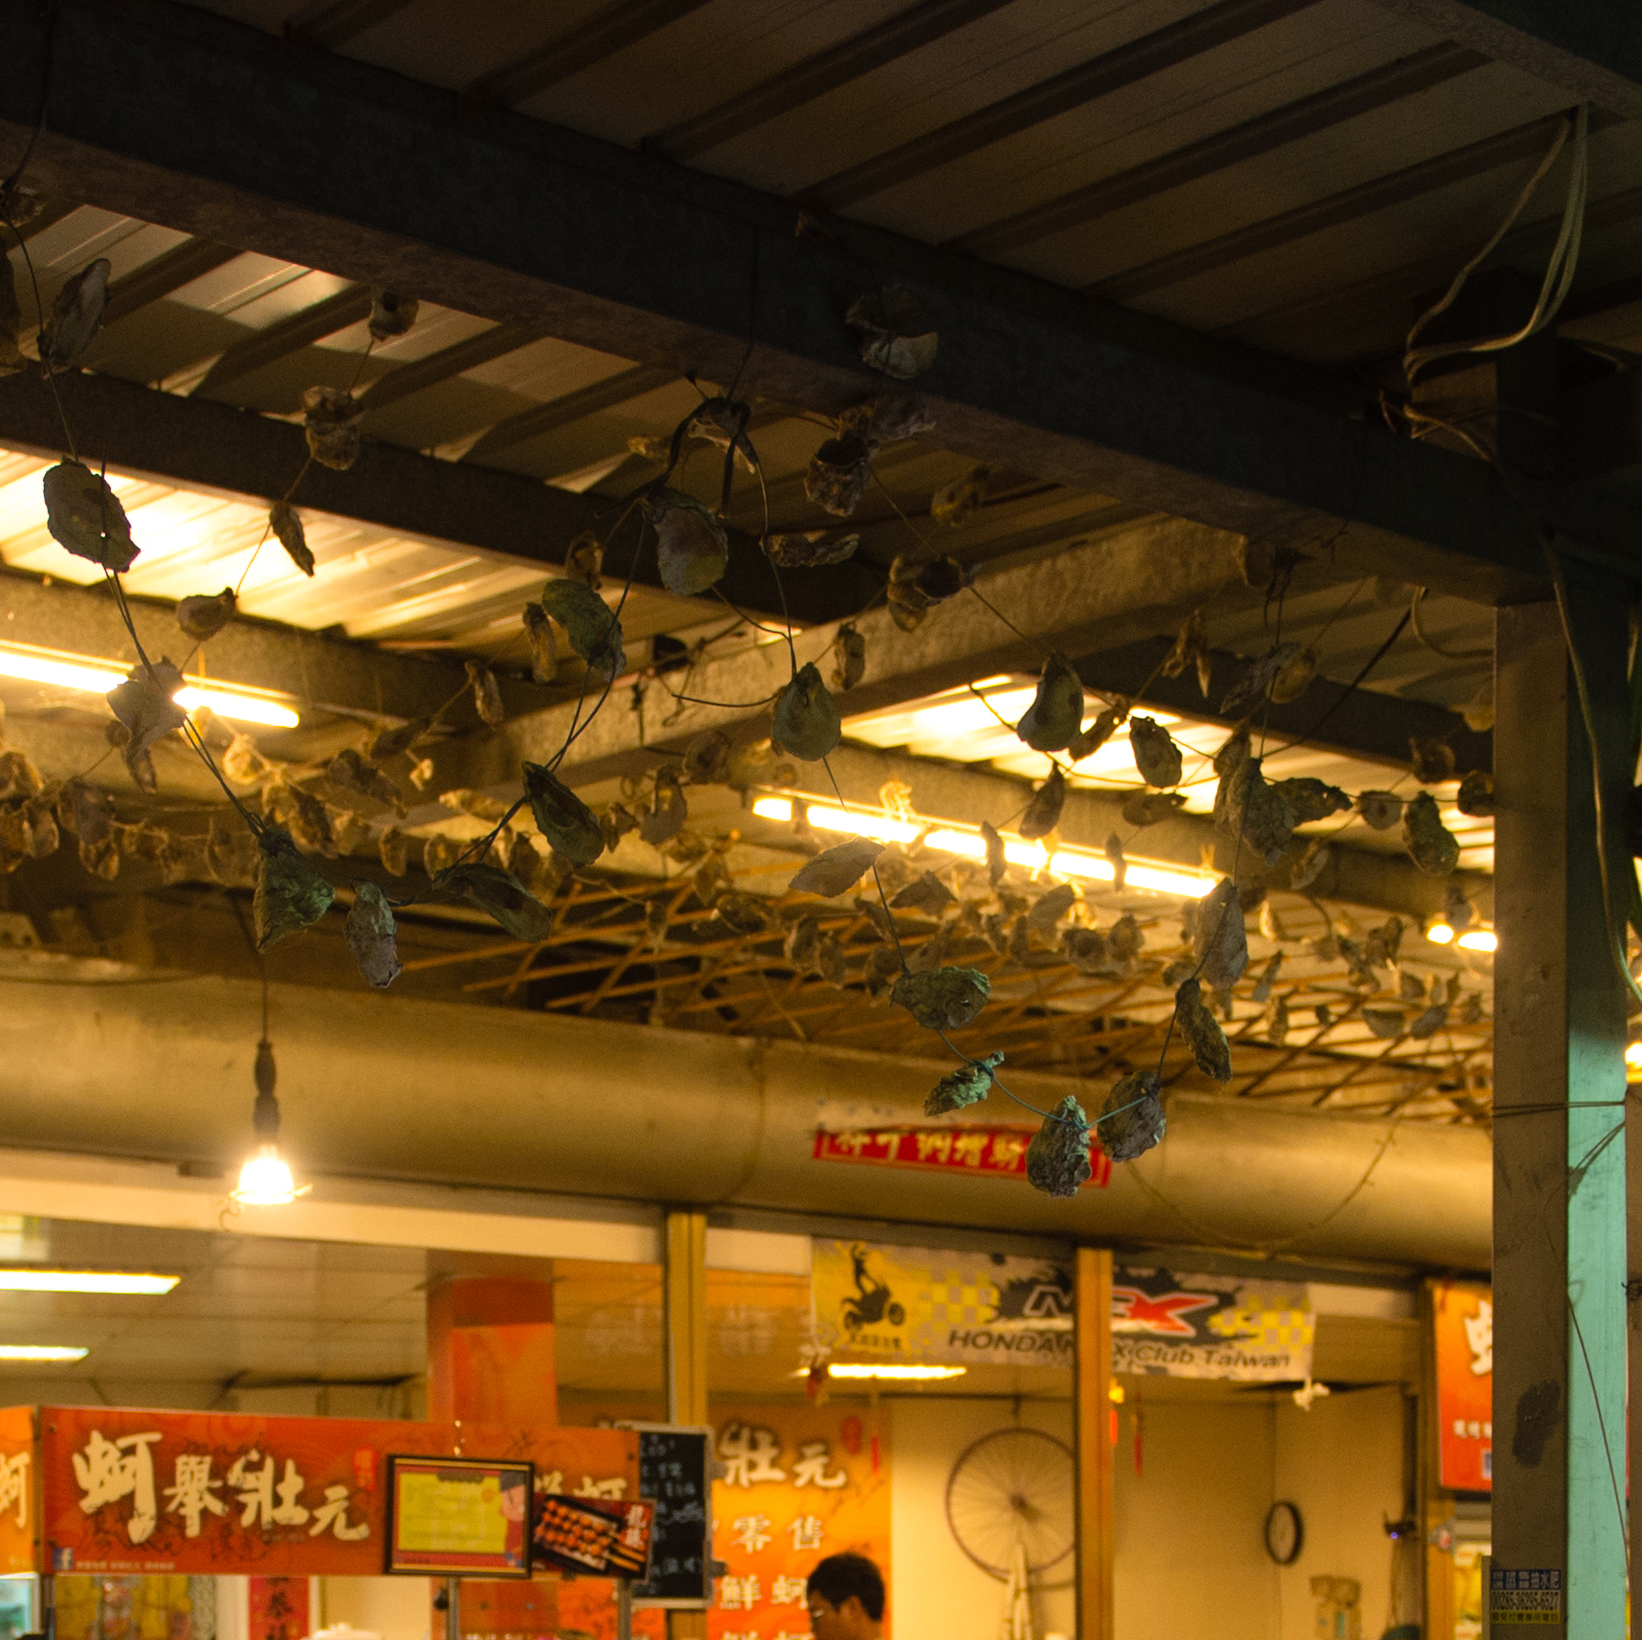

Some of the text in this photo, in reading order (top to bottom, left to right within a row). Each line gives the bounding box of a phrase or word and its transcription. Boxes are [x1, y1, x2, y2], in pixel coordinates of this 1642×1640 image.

[948, 1328, 1054, 1354] HONDA
[1135, 1343, 1196, 1365] Club
[1203, 1350, 1291, 1369] Taiwan
[72, 1428, 371, 1545] 蚵舉壯元
